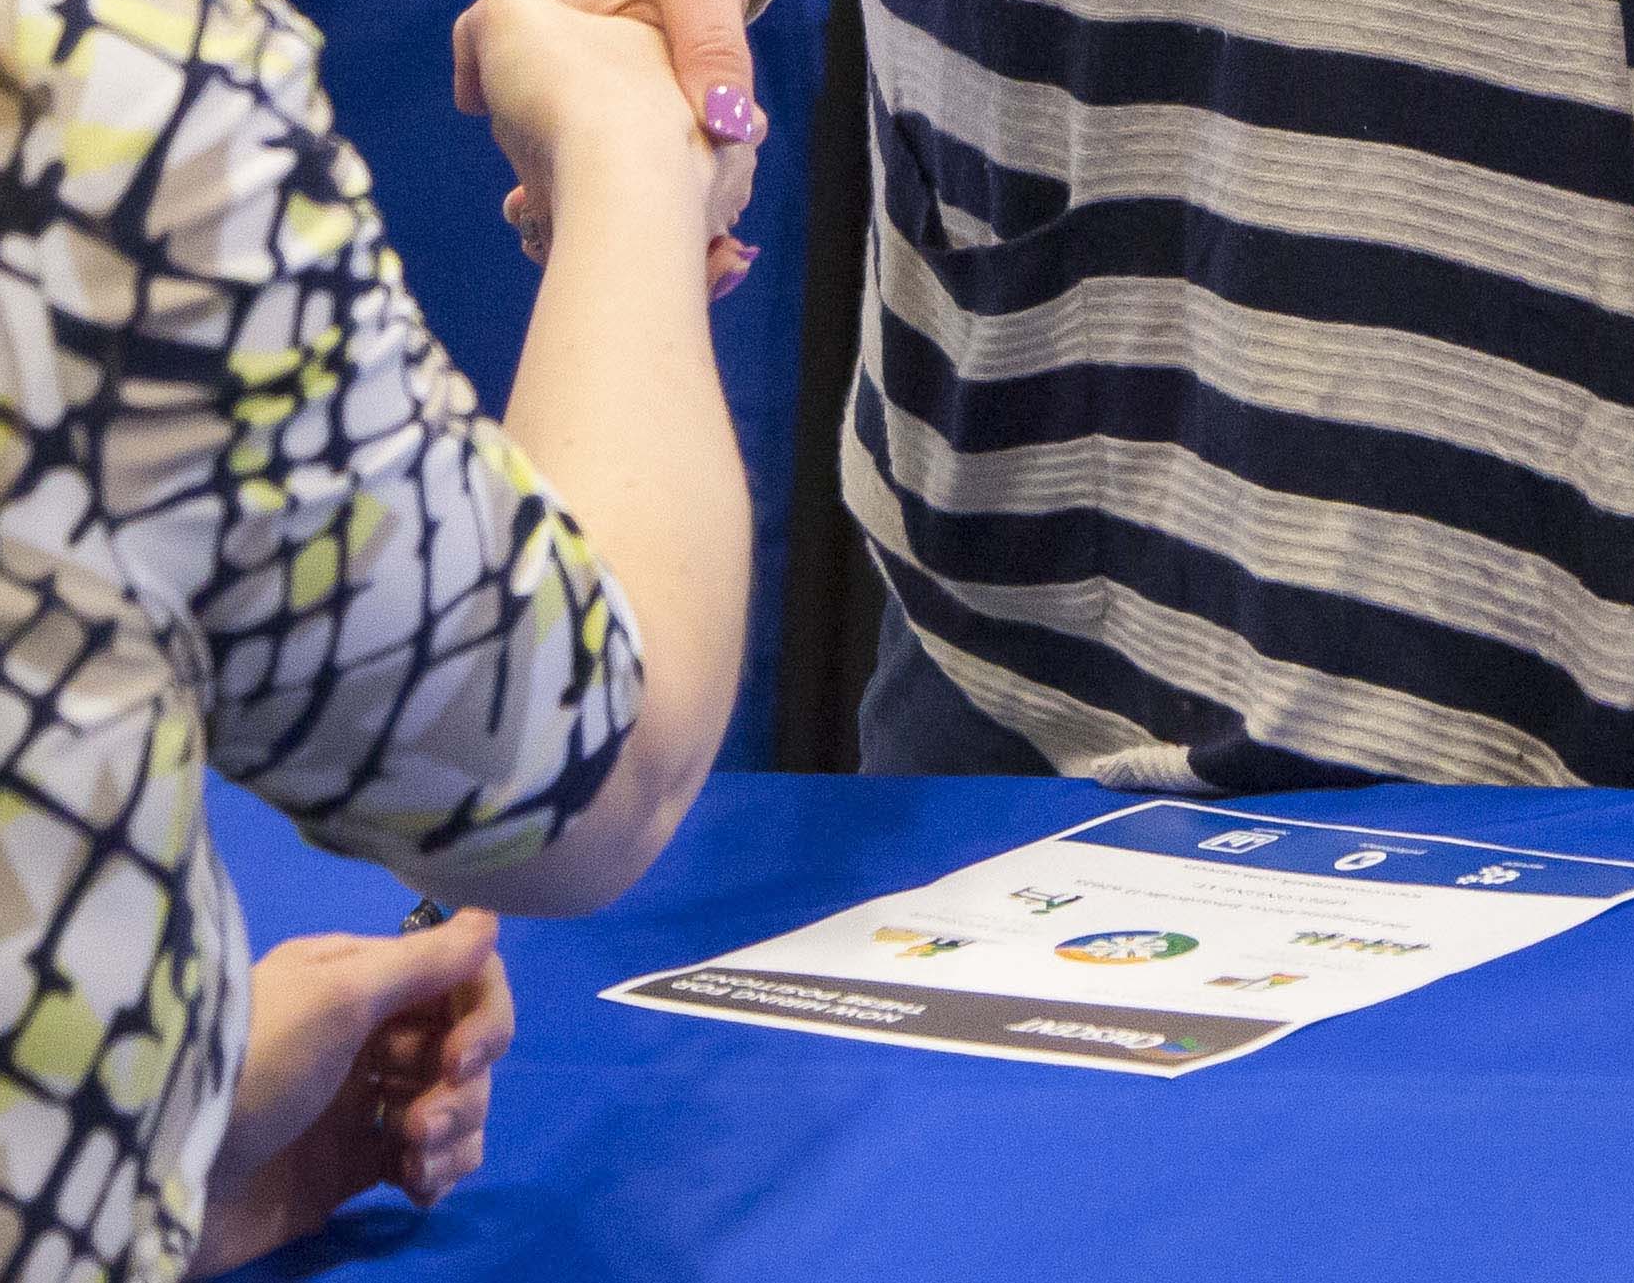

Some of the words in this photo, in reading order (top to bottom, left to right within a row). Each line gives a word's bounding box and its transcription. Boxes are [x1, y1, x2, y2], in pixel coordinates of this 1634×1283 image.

[670, 979, 733, 996] FOR
[690, 972, 842, 1000] POSITIONS
[730, 988, 832, 1011] HIRING
[836, 993, 927, 1016] THESE
[827, 1003, 904, 1024] NOW
[1005, 1017, 1166, 1049] CRESCENT
